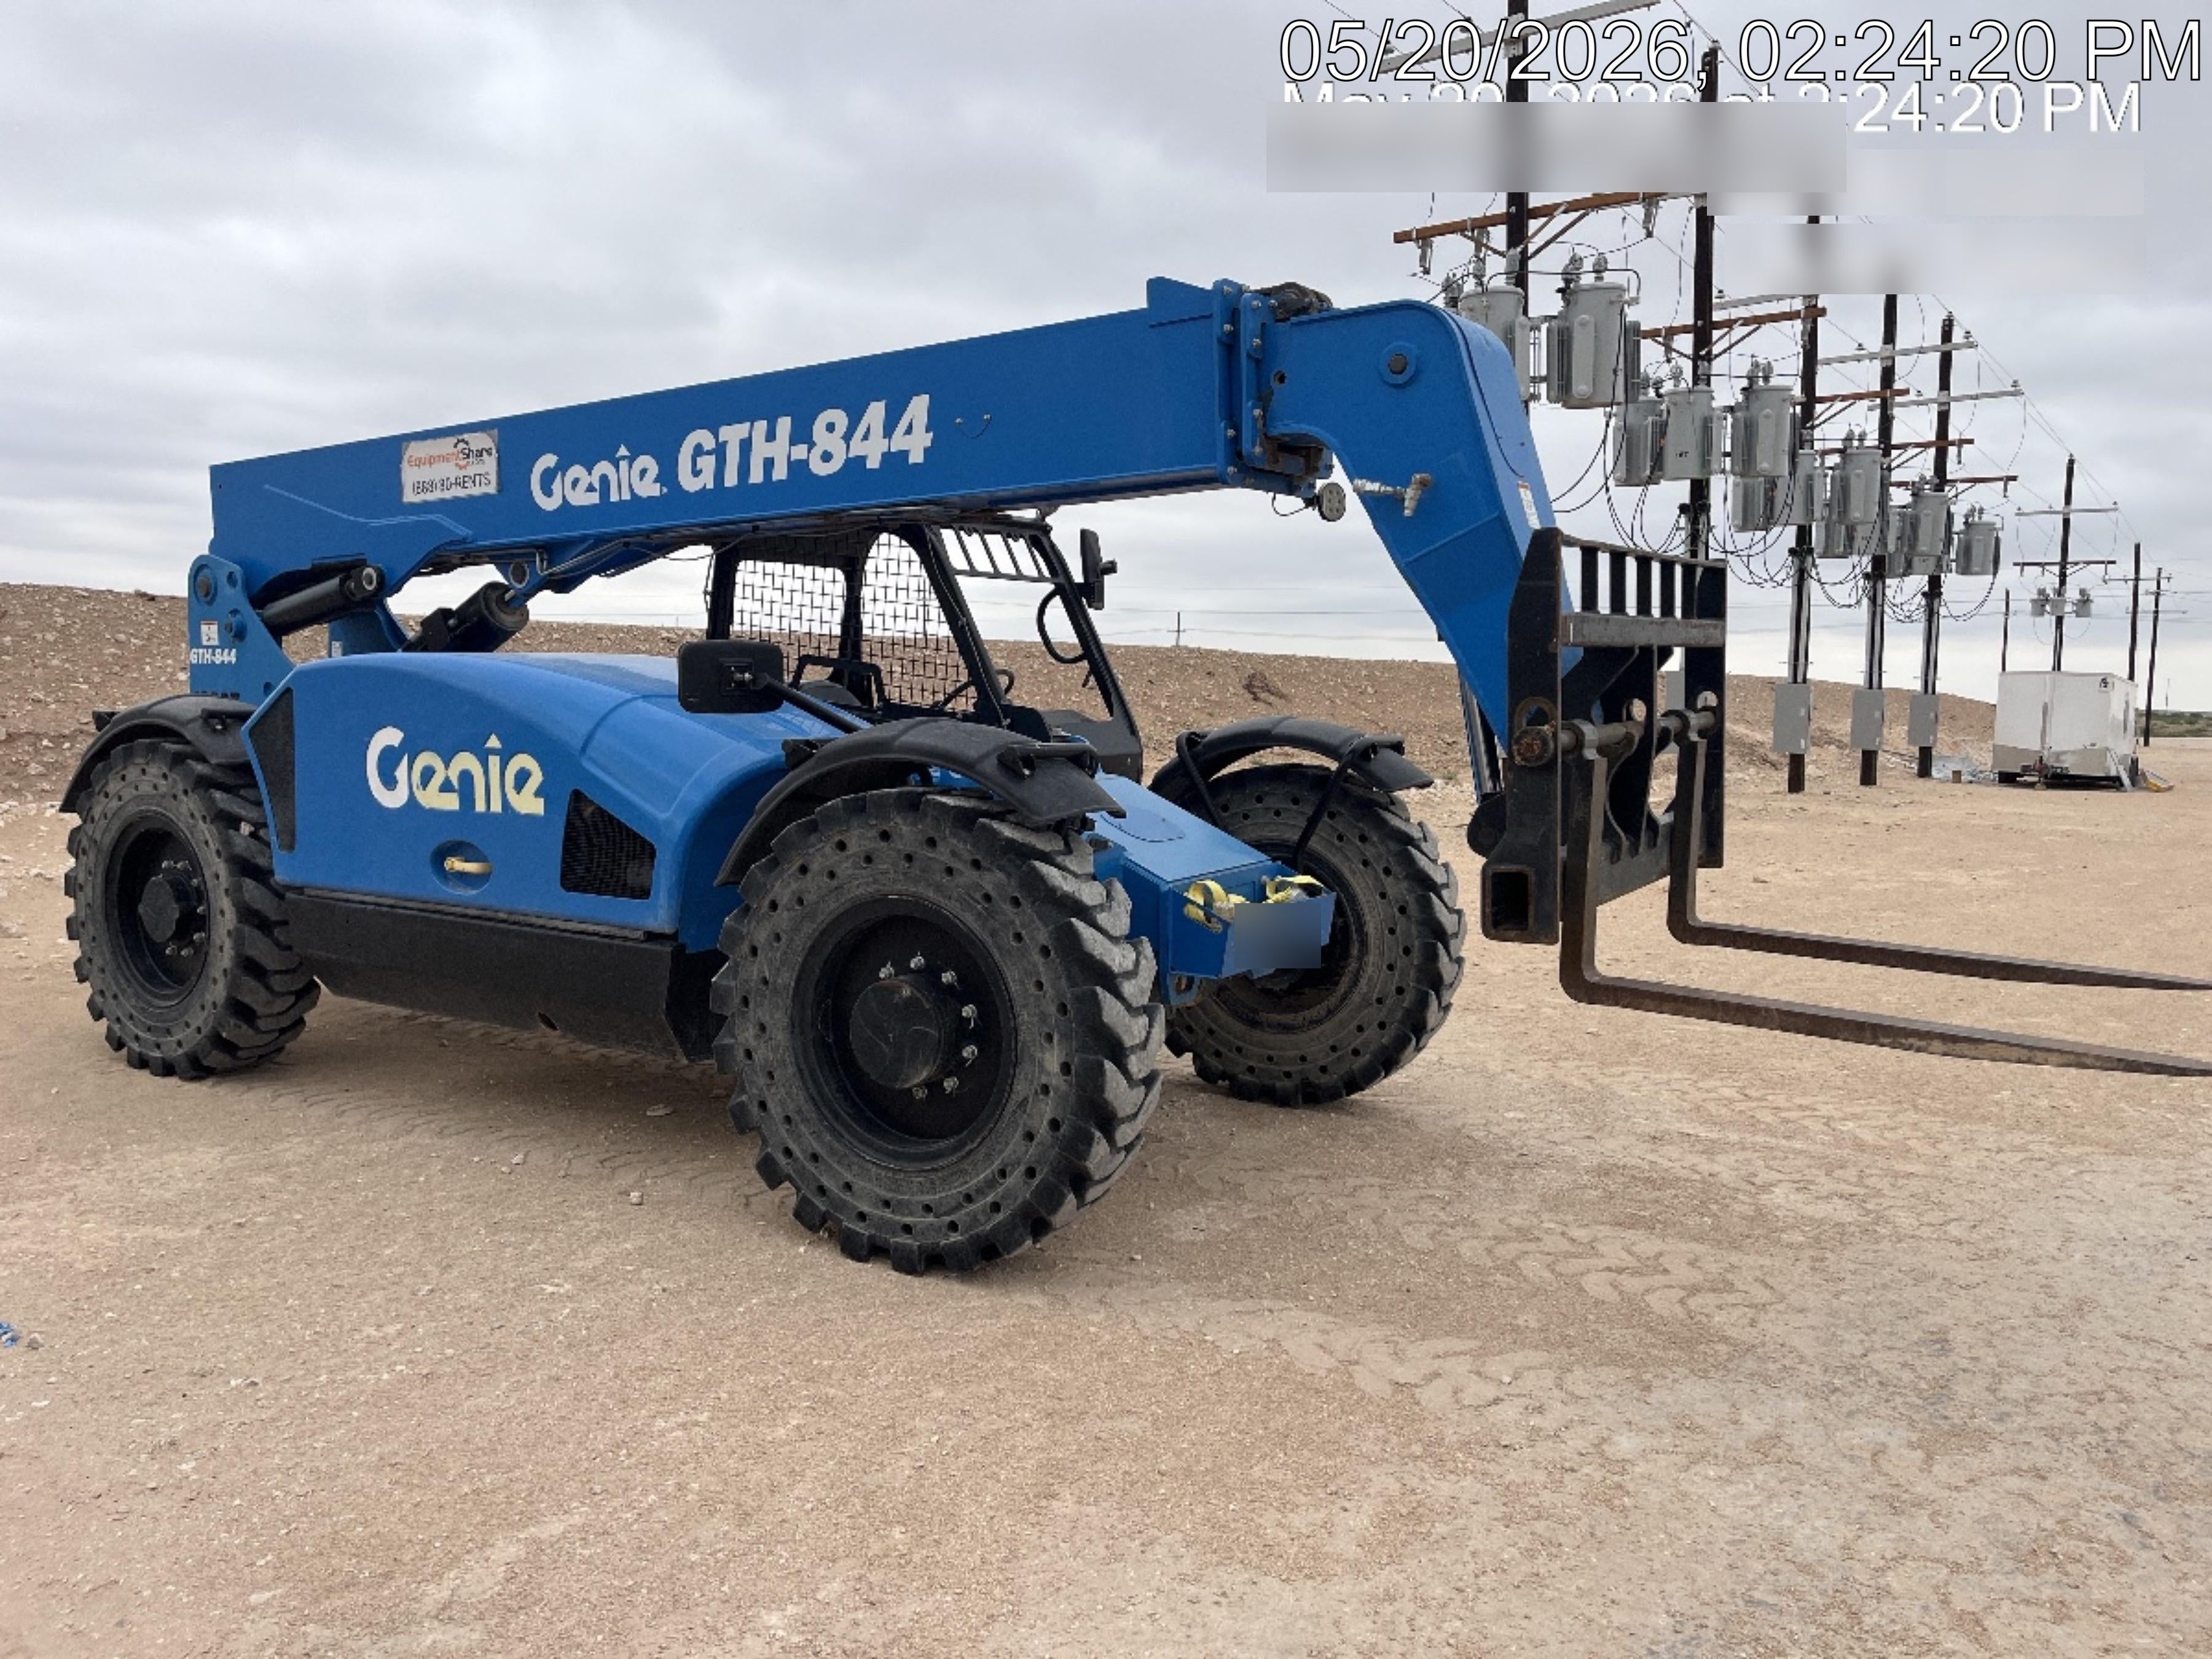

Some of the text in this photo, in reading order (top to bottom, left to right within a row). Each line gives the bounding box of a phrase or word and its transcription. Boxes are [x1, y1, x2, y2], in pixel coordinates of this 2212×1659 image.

[531, 393, 933, 511] Genie GTH-844
[189, 648, 237, 664] GTH-844
[367, 726, 544, 815] Genie
